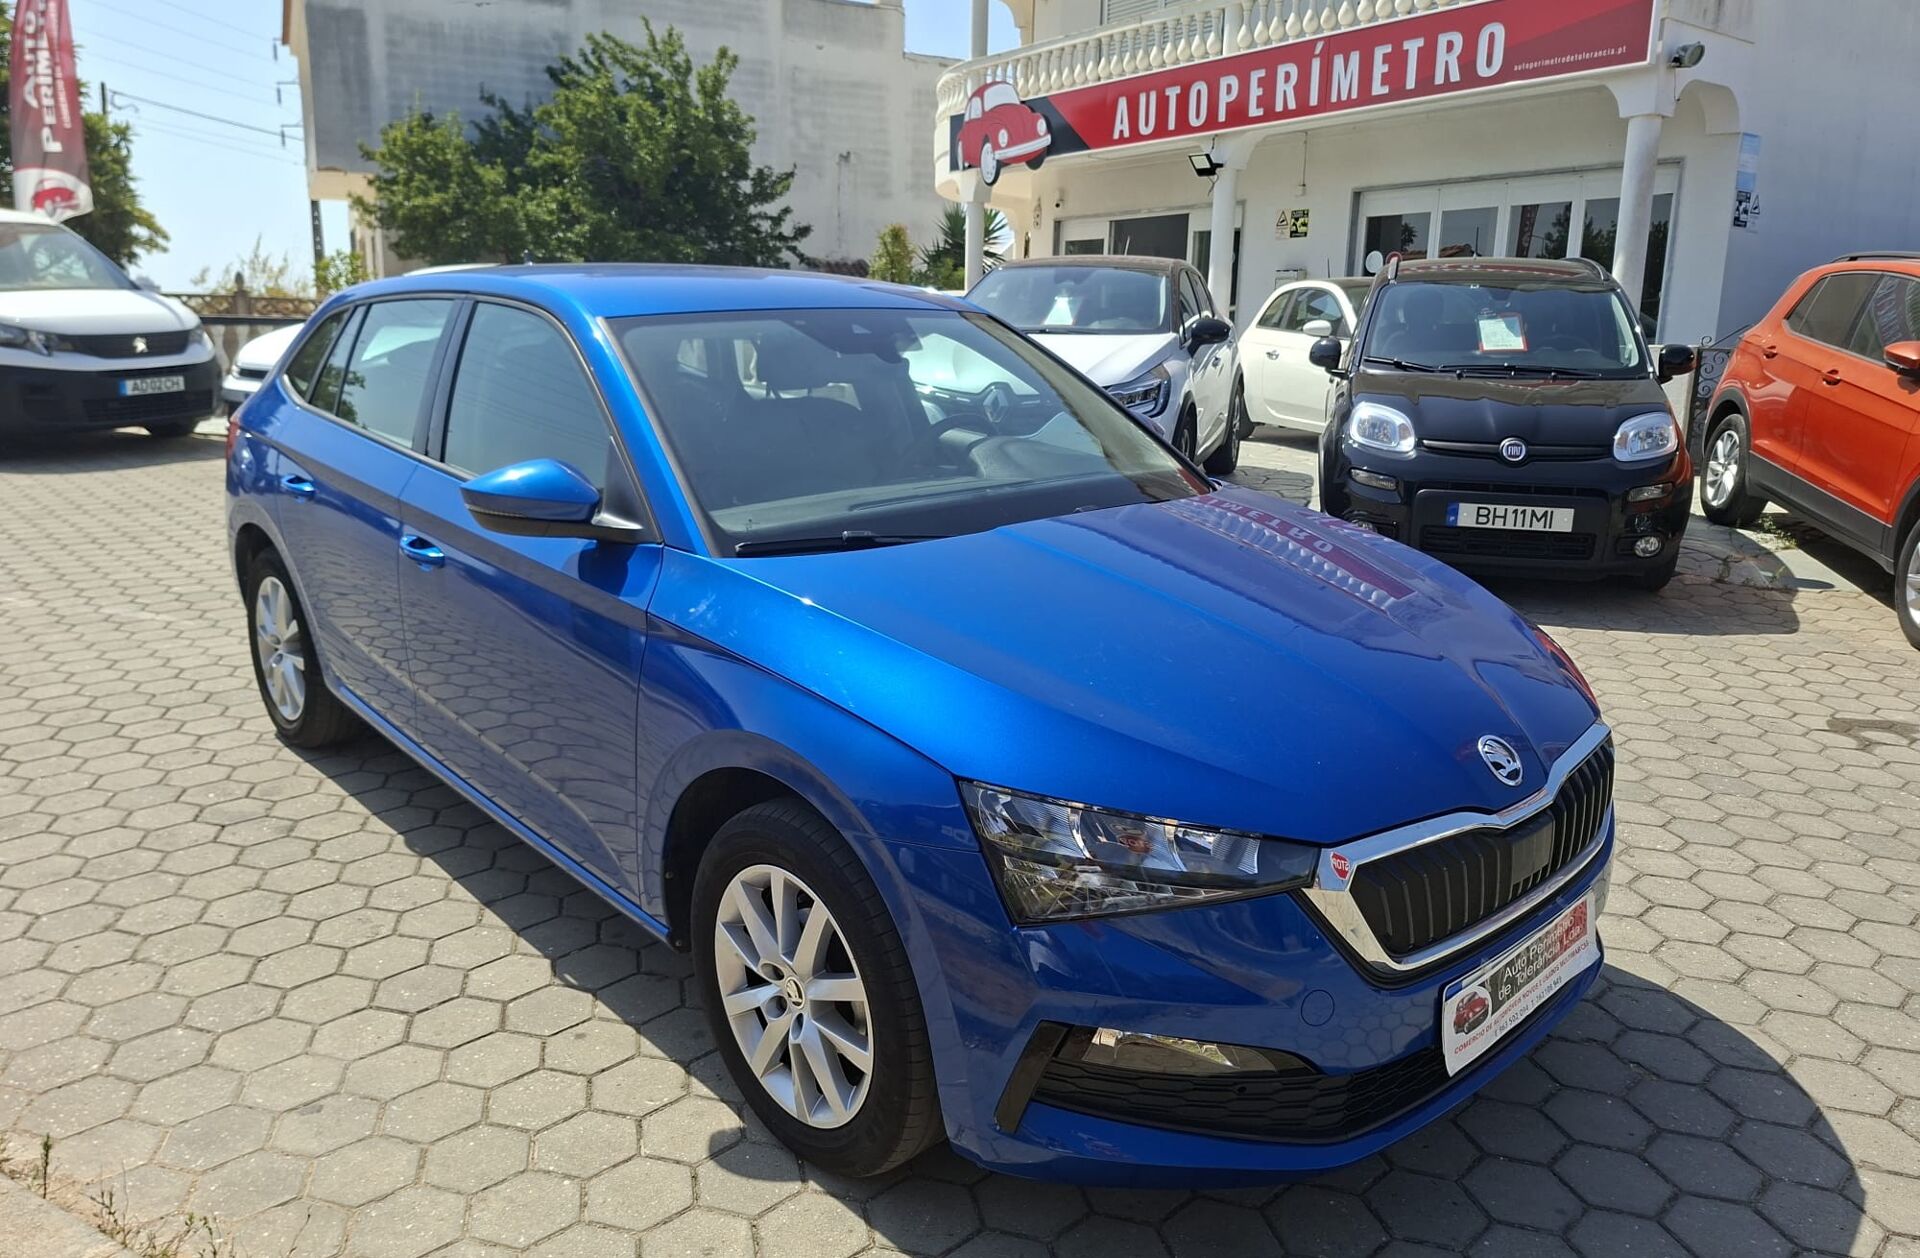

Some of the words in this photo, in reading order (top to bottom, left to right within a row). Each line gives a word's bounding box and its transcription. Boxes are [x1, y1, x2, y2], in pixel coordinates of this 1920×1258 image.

[1112, 22, 1505, 140] AUTOPERÍMETRO
[1475, 506, 1554, 529] BH11MI
[1503, 957, 1527, 981] Auto
[1498, 983, 1512, 1001] de
